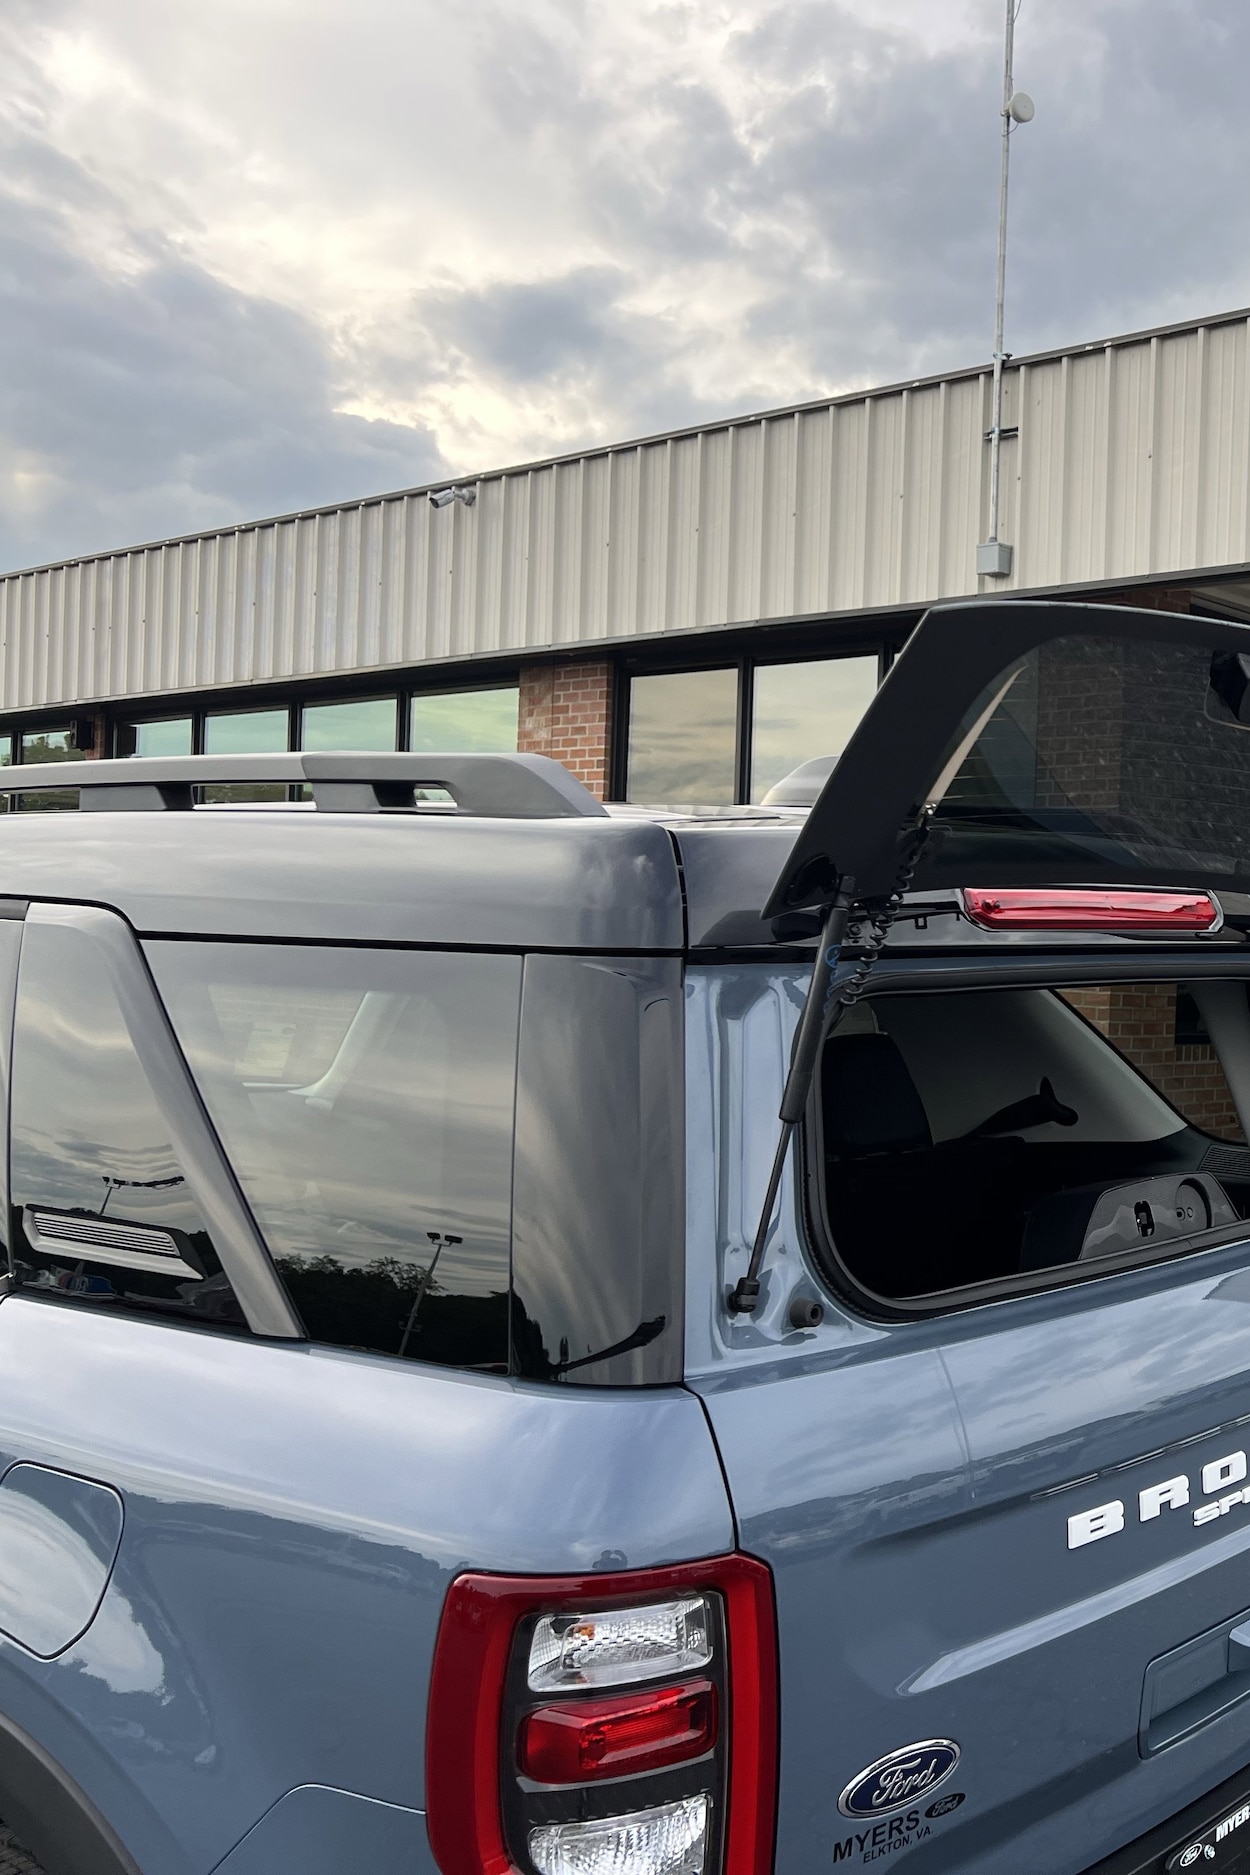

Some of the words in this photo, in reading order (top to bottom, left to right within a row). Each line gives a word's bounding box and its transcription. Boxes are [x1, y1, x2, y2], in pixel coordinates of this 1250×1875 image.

[871, 1757, 938, 1806] Ford
[833, 1810, 920, 1863] MYERS
[931, 1795, 960, 1817] Ford
[863, 1834, 913, 1863] ELKTON,
